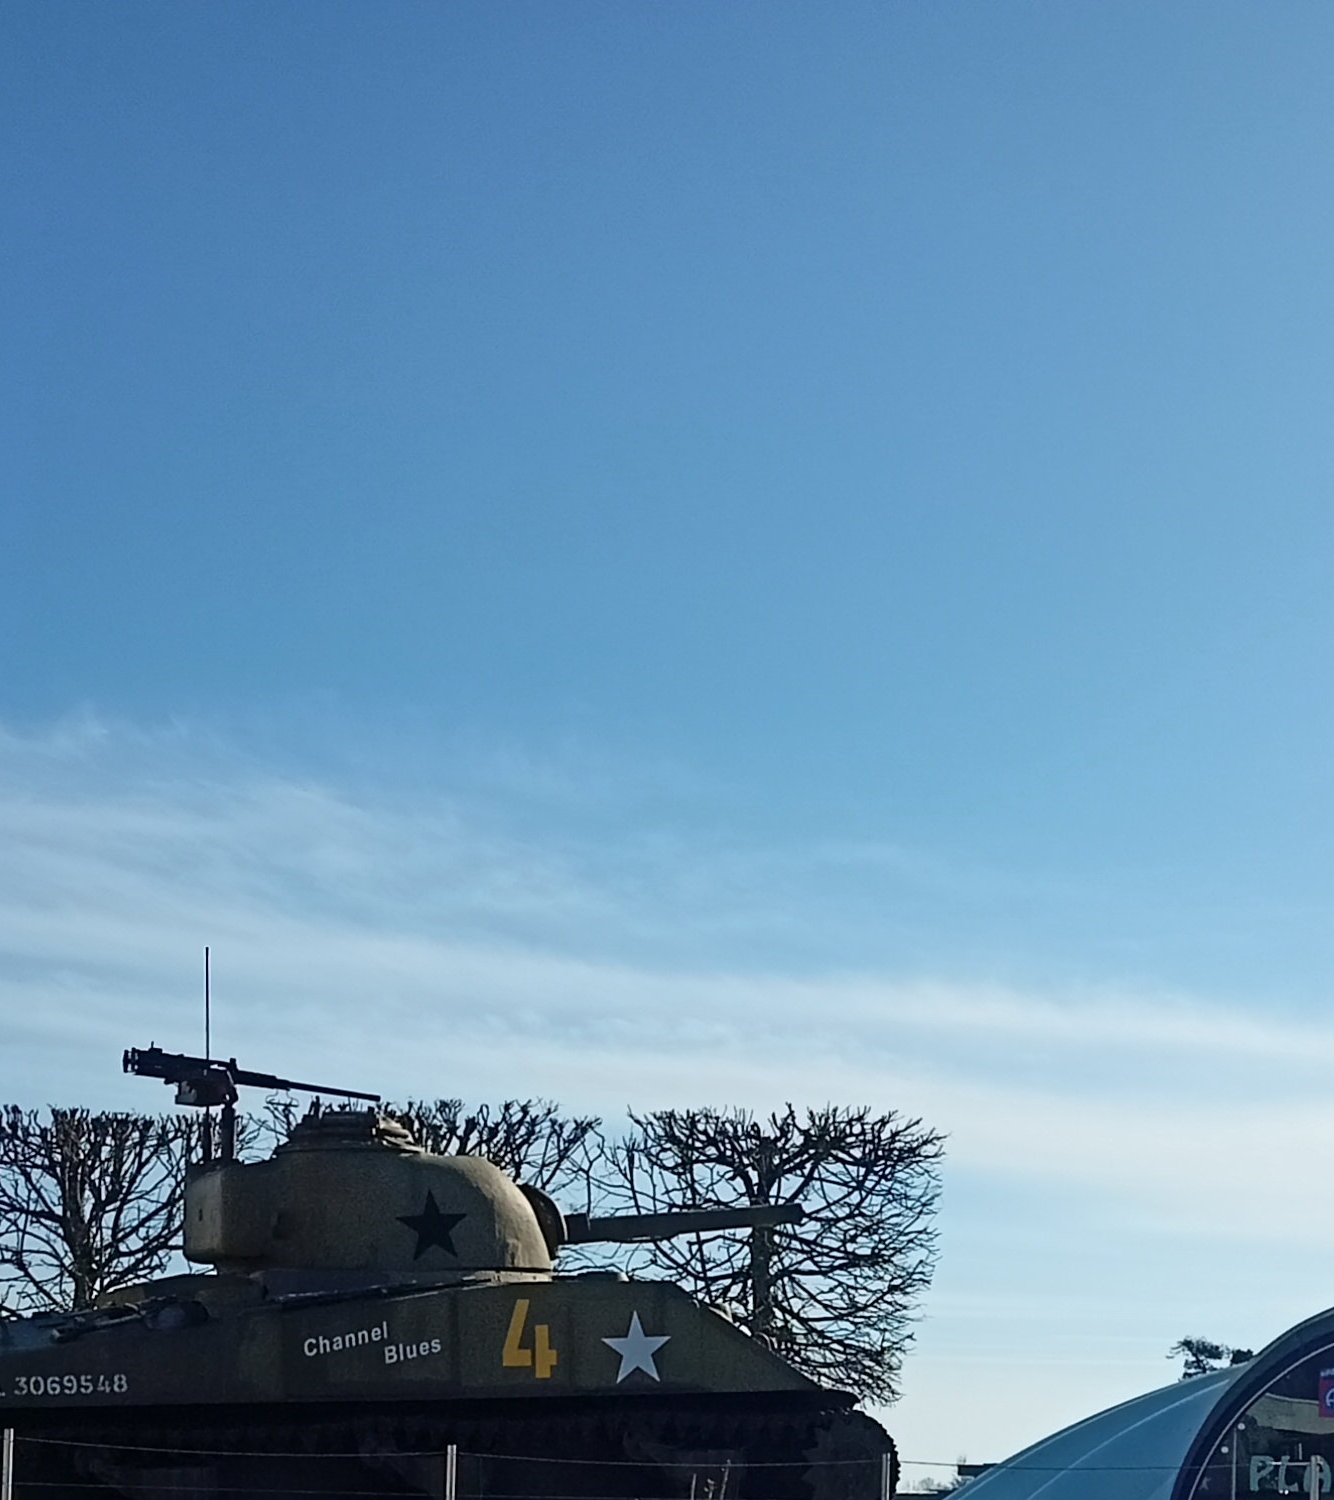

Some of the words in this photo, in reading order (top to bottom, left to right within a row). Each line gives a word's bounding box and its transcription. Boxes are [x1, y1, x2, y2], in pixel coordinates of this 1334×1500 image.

[303, 1321, 389, 1357] Channel
[384, 1338, 442, 1364] Blues
[502, 1299, 557, 1378] 4
[14, 1374, 128, 1395] 3069548
